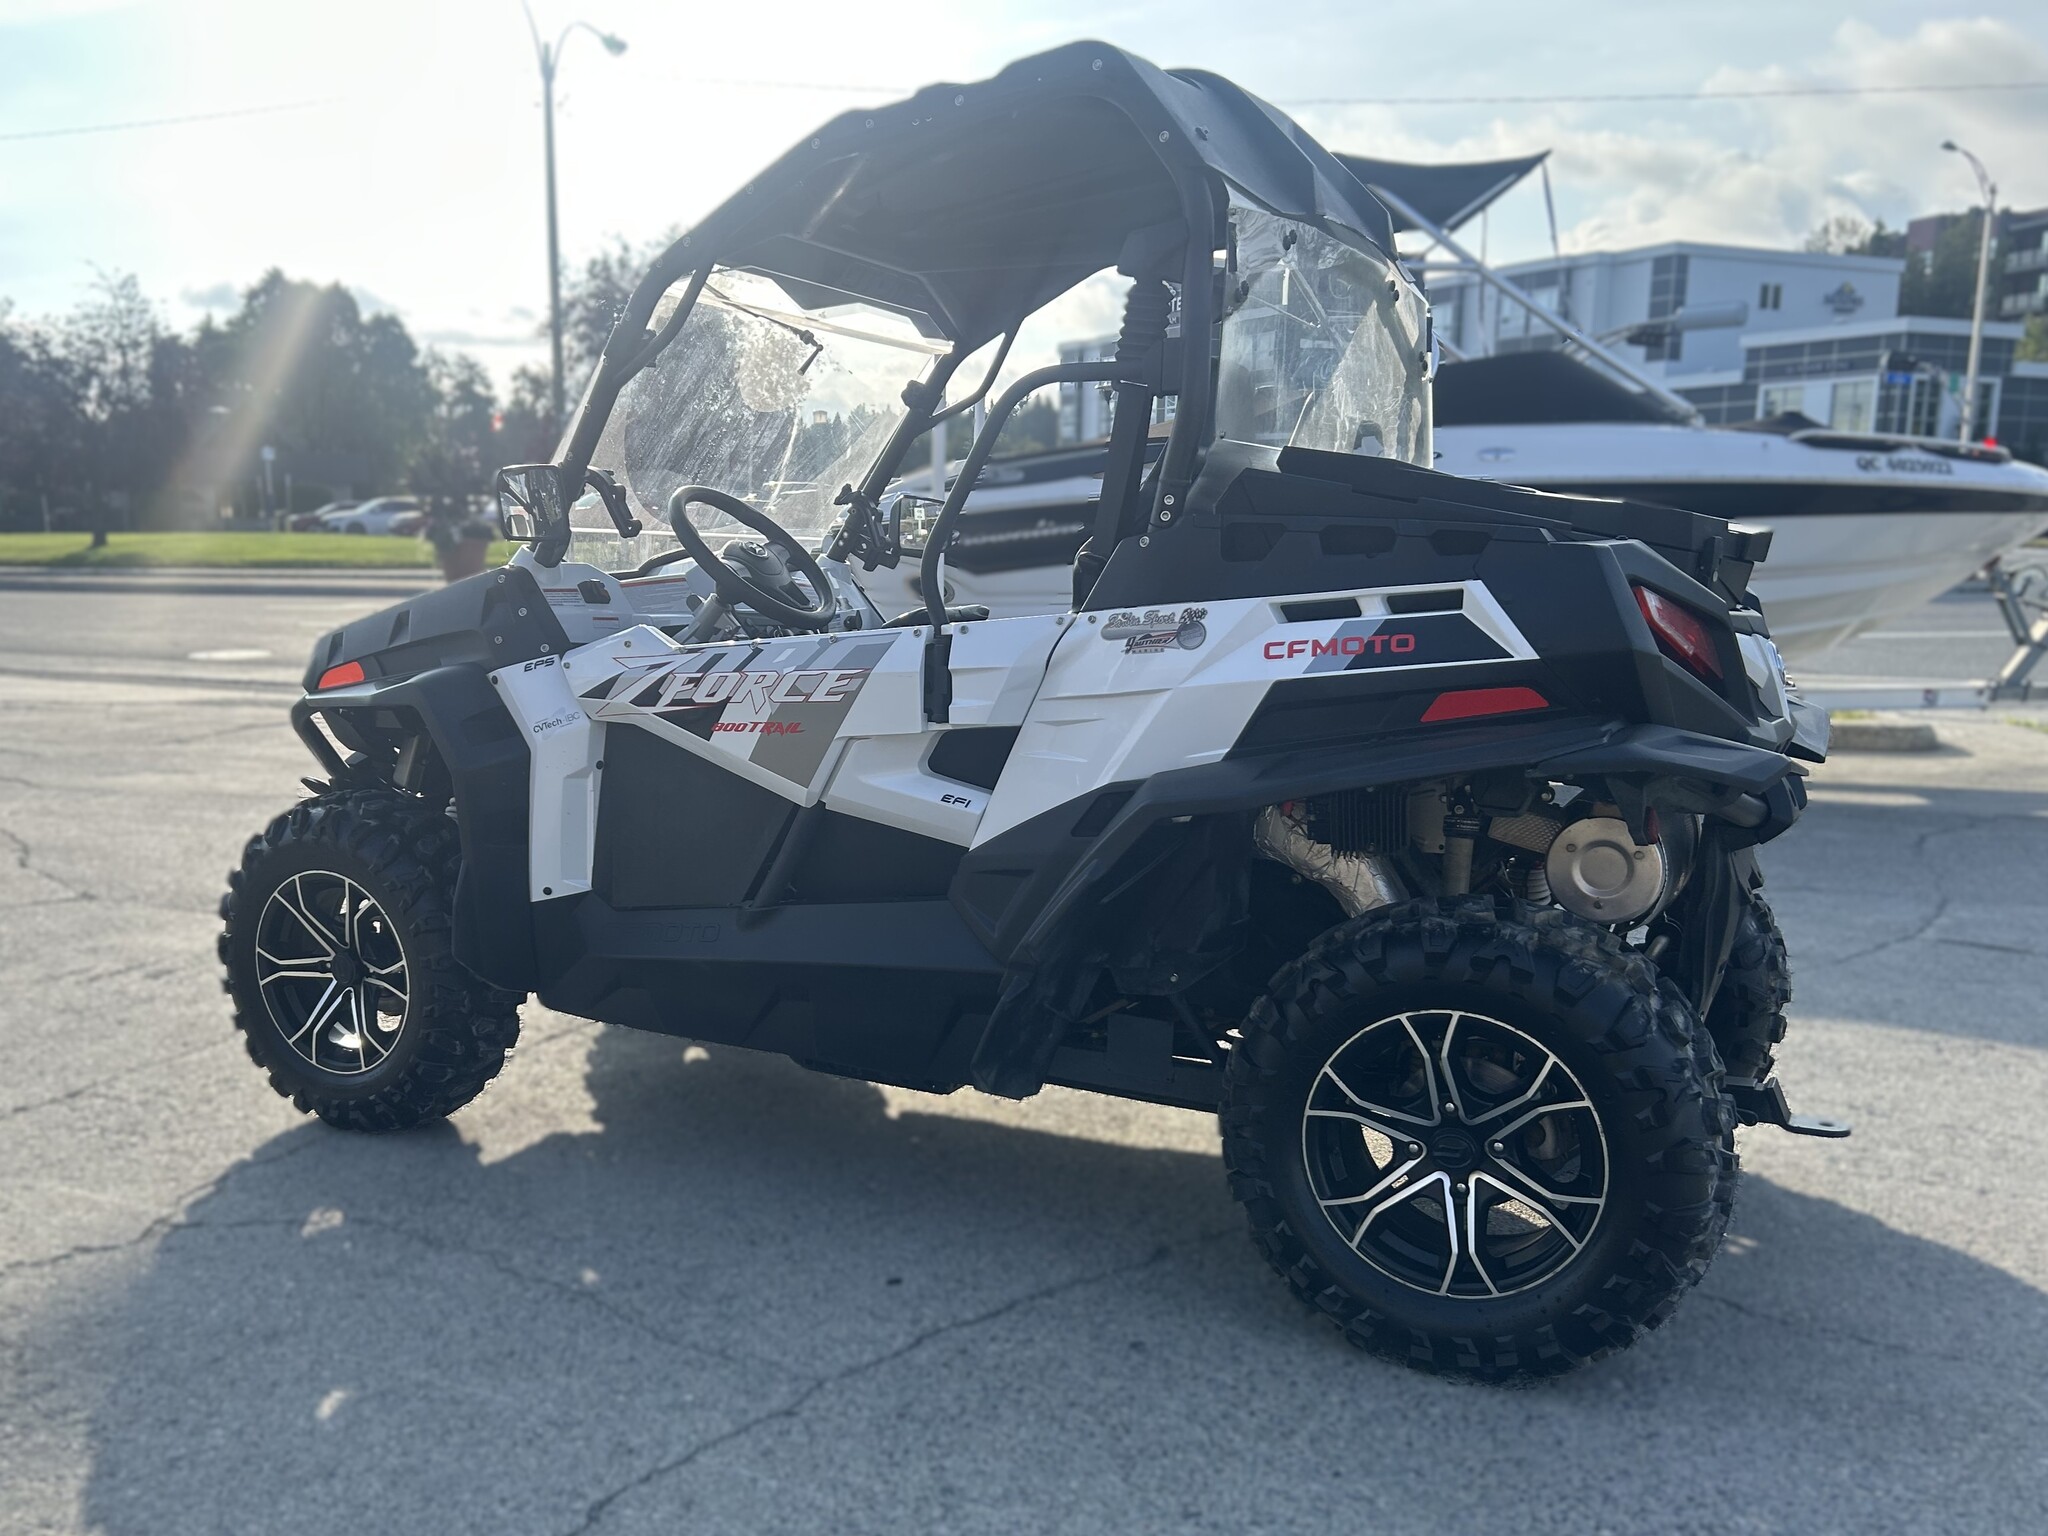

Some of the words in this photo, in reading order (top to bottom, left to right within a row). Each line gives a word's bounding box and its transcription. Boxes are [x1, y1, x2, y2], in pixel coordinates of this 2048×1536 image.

[1143, 609, 1177, 628] Sport
[1263, 634, 1416, 660] CFMOTO
[523, 656, 556, 673] EPS
[940, 793, 972, 808] EFI
